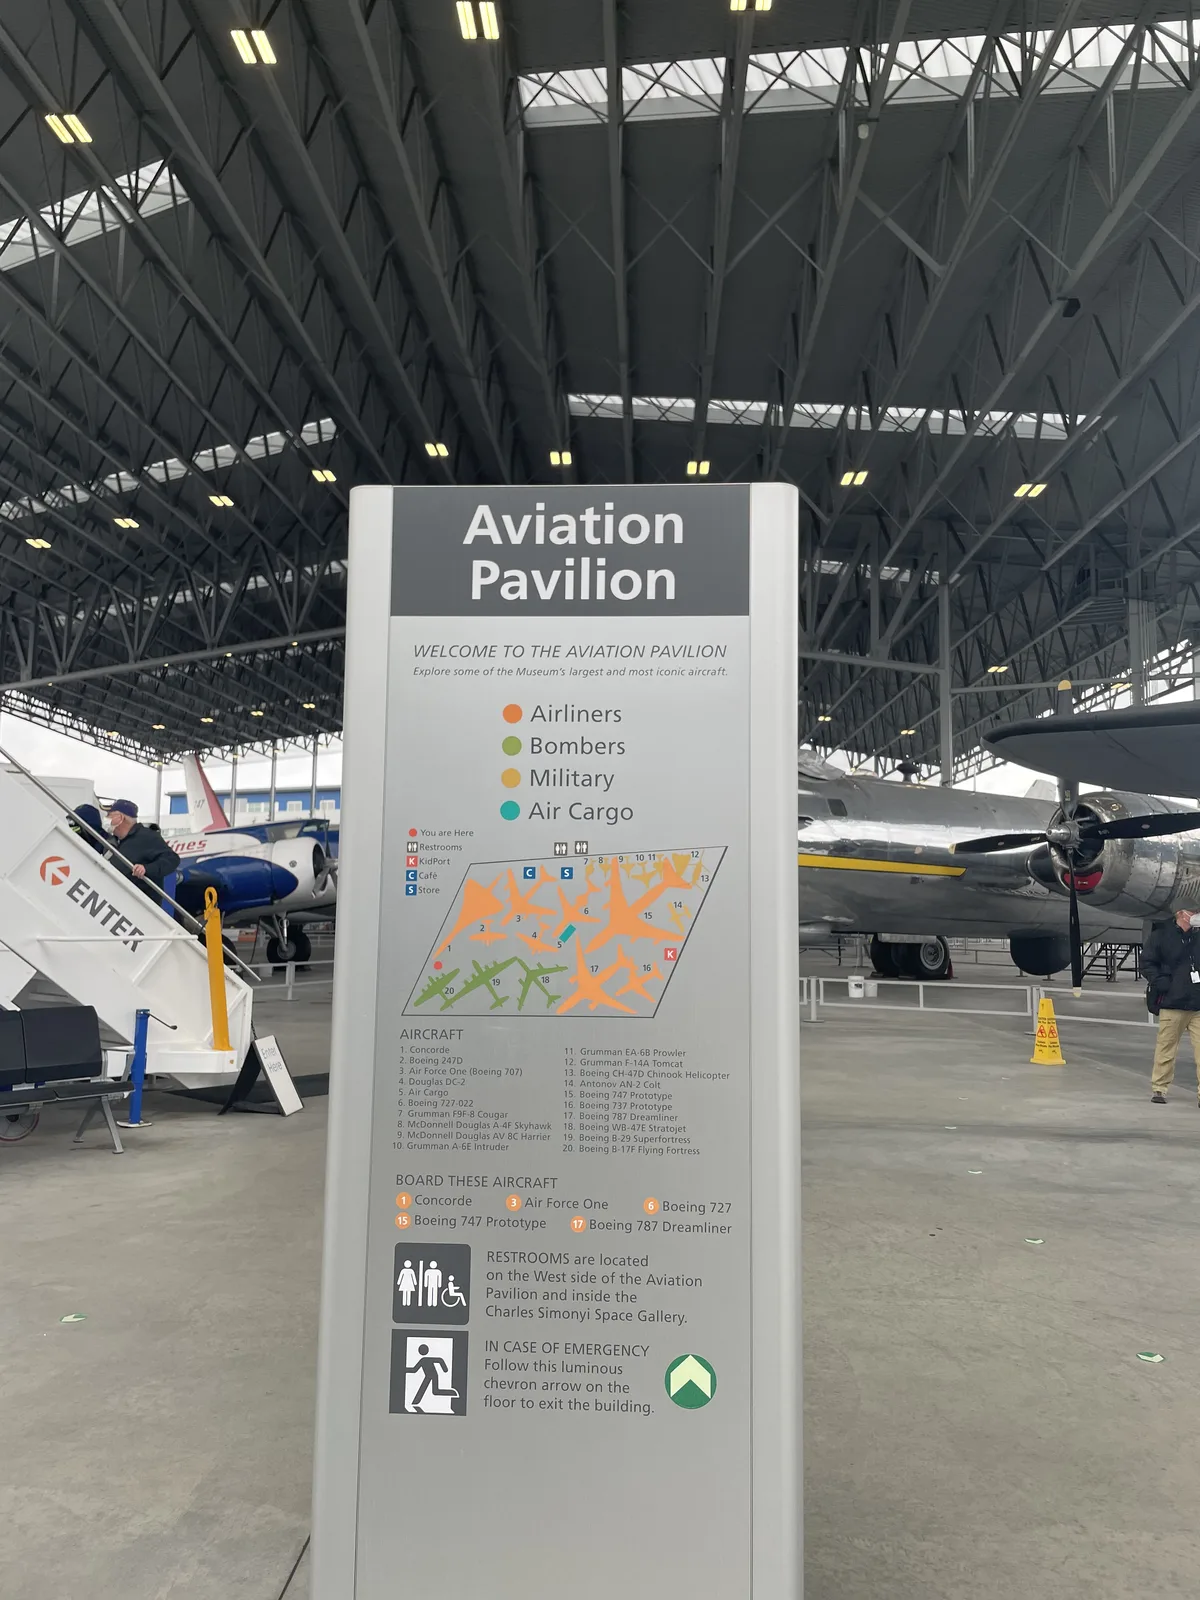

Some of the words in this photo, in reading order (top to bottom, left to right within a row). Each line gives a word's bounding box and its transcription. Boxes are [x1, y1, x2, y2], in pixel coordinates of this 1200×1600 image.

[462, 502, 683, 545] Aviation
[472, 557, 675, 601] Pavilion
[414, 644, 498, 658] WELCOME
[503, 645, 525, 658] TO
[531, 645, 562, 658] THE
[565, 645, 646, 658] AVIATION
[650, 645, 727, 658] PAVILION
[413, 667, 451, 678] Explore
[482, 666, 495, 676] of
[497, 667, 514, 676] the
[516, 667, 566, 677] Museum's
[569, 667, 604, 679] largest
[606, 667, 627, 677] and
[628, 668, 654, 677] most
[656, 667, 686, 677] iconic
[688, 667, 728, 676] aircraft.
[530, 704, 622, 723] Airliners
[531, 736, 626, 755] Bombers
[530, 768, 615, 792] Military
[528, 801, 561, 820] Air
[569, 802, 634, 826] Cargo
[420, 829, 436, 837] You
[420, 843, 463, 852] Restrooms
[419, 857, 450, 866] KidPort
[418, 871, 438, 880] Café
[418, 886, 440, 894] Store
[66, 878, 144, 952] ENTER
[399, 1028, 464, 1040] AIRCRAFT
[409, 1046, 450, 1054] Concorde
[580, 1047, 623, 1056] Grumman
[653, 1049, 686, 1058] Prowler
[409, 1056, 439, 1067] Boeing
[441, 1056, 463, 1065] 247D
[580, 1058, 623, 1067] Grumman
[625, 1058, 650, 1067] F-14A
[652, 1059, 683, 1068] Tomcat
[409, 1067, 422, 1075] Air
[424, 1067, 447, 1076] Force
[449, 1067, 467, 1076] One
[469, 1067, 502, 1078] (Boeing
[505, 1068, 523, 1077] 707)
[580, 1068, 610, 1080] Boeing
[612, 1069, 645, 1078] CH-47D
[647, 1070, 683, 1079] Chinook
[685, 1071, 730, 1081] Helicopter
[409, 1077, 443, 1088] Douglas
[445, 1078, 466, 1086] DC-2
[579, 1080, 617, 1088] Antonov
[619, 1080, 641, 1089] AN-2
[643, 1080, 661, 1089] Colt
[408, 1088, 421, 1096] Air
[423, 1088, 449, 1099] Cargo
[579, 1090, 610, 1101] Boeing
[612, 1091, 628, 1099] 747
[630, 1091, 673, 1102] Prototype
[408, 1099, 438, 1109] Boeing
[441, 1099, 474, 1108] 727-022
[579, 1101, 610, 1112] Boeing
[630, 1102, 673, 1113] Prototype
[407, 1109, 450, 1118] Grumman
[477, 1110, 509, 1121] Cougar
[579, 1112, 610, 1123] Boeing
[612, 1112, 628, 1121] 787
[630, 1113, 678, 1122] Dreamliner
[407, 1120, 454, 1129] McDonnell
[456, 1120, 491, 1131] Douglas
[514, 1121, 552, 1132] Skyhawk
[579, 1122, 610, 1133] Boeing
[612, 1123, 646, 1132] WB-47E
[648, 1124, 686, 1135] Stratojet
[407, 1131, 453, 1140] McDonnell
[455, 1131, 491, 1142] Douglas
[521, 1132, 551, 1141] Harrier
[579, 1133, 610, 1144] Boeing
[612, 1134, 631, 1143] B-29
[633, 1134, 691, 1145] Superfortress
[407, 1142, 450, 1150] Grumman
[451, 1142, 472, 1151] A-6E
[474, 1142, 509, 1151] Intruder
[579, 1144, 609, 1155] Boeing
[638, 1145, 664, 1156] Flying
[666, 1146, 700, 1155] Fortress
[396, 1174, 444, 1186] BOARD
[448, 1175, 488, 1188] THESE
[492, 1176, 558, 1189] AIRCRAFT
[414, 1194, 472, 1206] Concorde
[524, 1197, 543, 1208] Air
[547, 1198, 579, 1209] Force
[583, 1198, 609, 1210] One
[648, 1202, 654, 1210] 6
[663, 1200, 706, 1216] Boeing
[710, 1202, 732, 1214] 727
[398, 1216, 408, 1225] 15
[414, 1214, 457, 1229] Boeing
[461, 1215, 482, 1227] 747
[486, 1216, 547, 1231] Prototype
[573, 1220, 583, 1228] 17
[589, 1219, 632, 1234] Boeing
[636, 1220, 658, 1232] 787
[663, 1221, 732, 1234] Dreamliner
[487, 1251, 570, 1265] RESTROOMS
[574, 1256, 595, 1266] are
[600, 1253, 649, 1267] located
[486, 1272, 503, 1281] on
[507, 1269, 530, 1282] the
[533, 1270, 567, 1283] West
[571, 1271, 597, 1284] side
[601, 1271, 616, 1284] of
[619, 1272, 642, 1286] the
[646, 1274, 703, 1287] Aviation
[486, 1287, 538, 1300] Pavilion
[542, 1288, 567, 1301] and
[572, 1289, 611, 1303] inside
[615, 1290, 637, 1303] the
[485, 1305, 534, 1319] Charles
[538, 1306, 590, 1323] Simonyi
[595, 1308, 633, 1324] Space
[637, 1310, 688, 1327] Gallery.
[485, 1340, 499, 1352] IN
[503, 1340, 537, 1354] CASE
[542, 1342, 560, 1354] OF
[564, 1342, 650, 1357] EMERGENCY
[485, 1358, 530, 1372] Follow
[533, 1360, 557, 1373] this
[562, 1360, 623, 1375] luminous
[484, 1376, 537, 1390] chevron
[541, 1381, 582, 1392] arrow
[586, 1383, 603, 1393] on
[607, 1380, 630, 1394] the
[483, 1394, 516, 1408] floor
[520, 1398, 535, 1409] to
[539, 1397, 564, 1410] exit
[568, 1398, 590, 1411] the
[595, 1398, 655, 1417] building.
